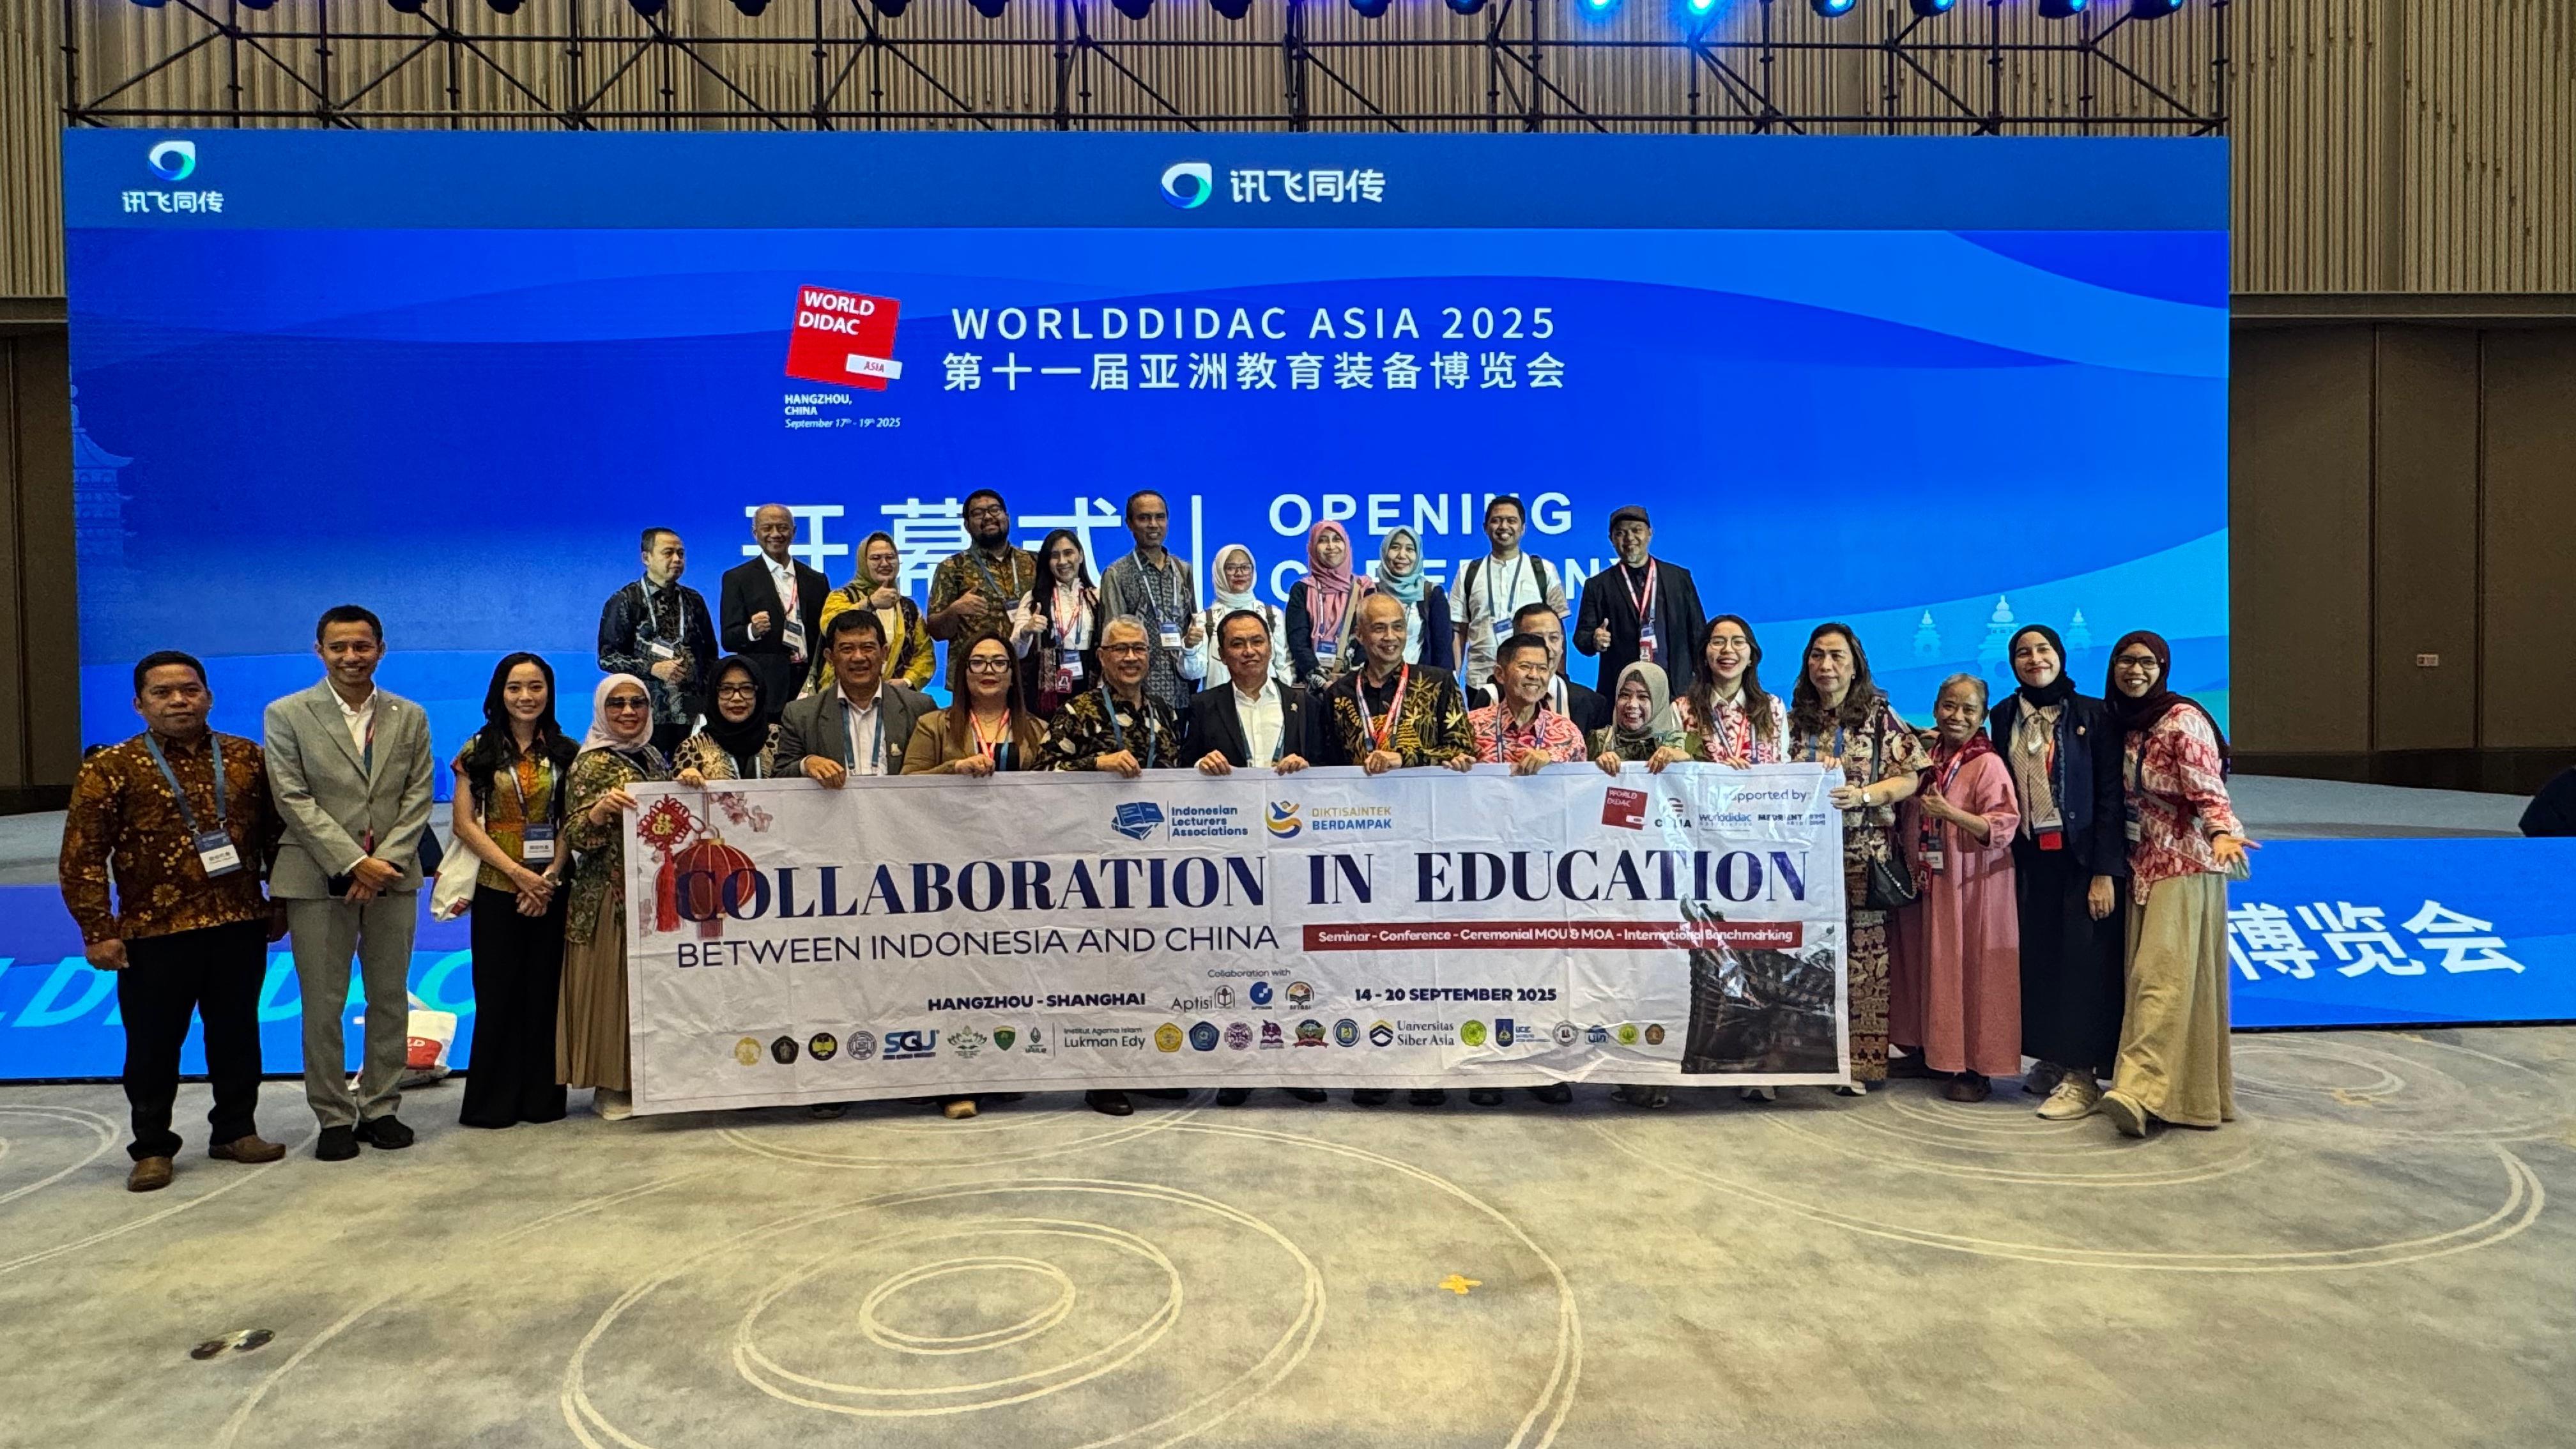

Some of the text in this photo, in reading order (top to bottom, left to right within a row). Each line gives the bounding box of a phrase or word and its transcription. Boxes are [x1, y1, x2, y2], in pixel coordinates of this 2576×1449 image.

[1230, 169, 1386, 203] 讯飞同传
[123, 190, 224, 213] 讯飞同传
[804, 291, 875, 316] WORLD
[799, 311, 860, 335] DIDAC
[952, 307, 1554, 340] WORLDDIDAC ASIA 2025
[864, 361, 884, 372] ASIA
[943, 352, 1565, 392] 第十一届亚洲教育装备博览会
[785, 394, 852, 405] HANGZHOU,
[785, 406, 818, 415] CHINA
[785, 418, 833, 429] September
[877, 418, 901, 427] 2025
[1269, 492, 1572, 537] OPENIG
[1609, 789, 1637, 799] WORLD
[1172, 805, 1238, 816] Indonesian
[1312, 806, 1392, 818] DIKTISAINTEK
[1172, 816, 1227, 827] Lecturers
[1312, 818, 1392, 831] BERDAMPAK
[1172, 826, 1248, 837] Associations
[677, 850, 1807, 923] COLLABORATION IN EDUCATION
[1319, 931, 1370, 942] Seminar
[1379, 930, 1451, 942] Conference
[1460, 928, 1533, 941] Ceremonial
[1535, 930, 1569, 940] MOU
[1581, 930, 1615, 940] MOA
[2228, 900, 2526, 981] 博览会
[678, 925, 1280, 968] BETWEEN INDONESIA AND CHINA
[1208, 968, 1291, 978] Collaboration with
[928, 995, 1034, 1011] HANGZHOU
[1046, 993, 1146, 1008] SHANGHAI
[1355, 988, 1372, 1001] 14
[1385, 988, 1406, 1001] 20
[1409, 988, 1513, 1002] SEPTEMBER
[1516, 988, 1557, 1002] 2025
[1171, 995, 1213, 1013] Aptisi
[1091, 1027, 1120, 1036] Agama
[1397, 1020, 1455, 1031] Universitas
[884, 1029, 937, 1053] SGU
[1064, 1035, 1146, 1050] Lukman Edy
[1397, 1034, 1455, 1046] Siber Asia
